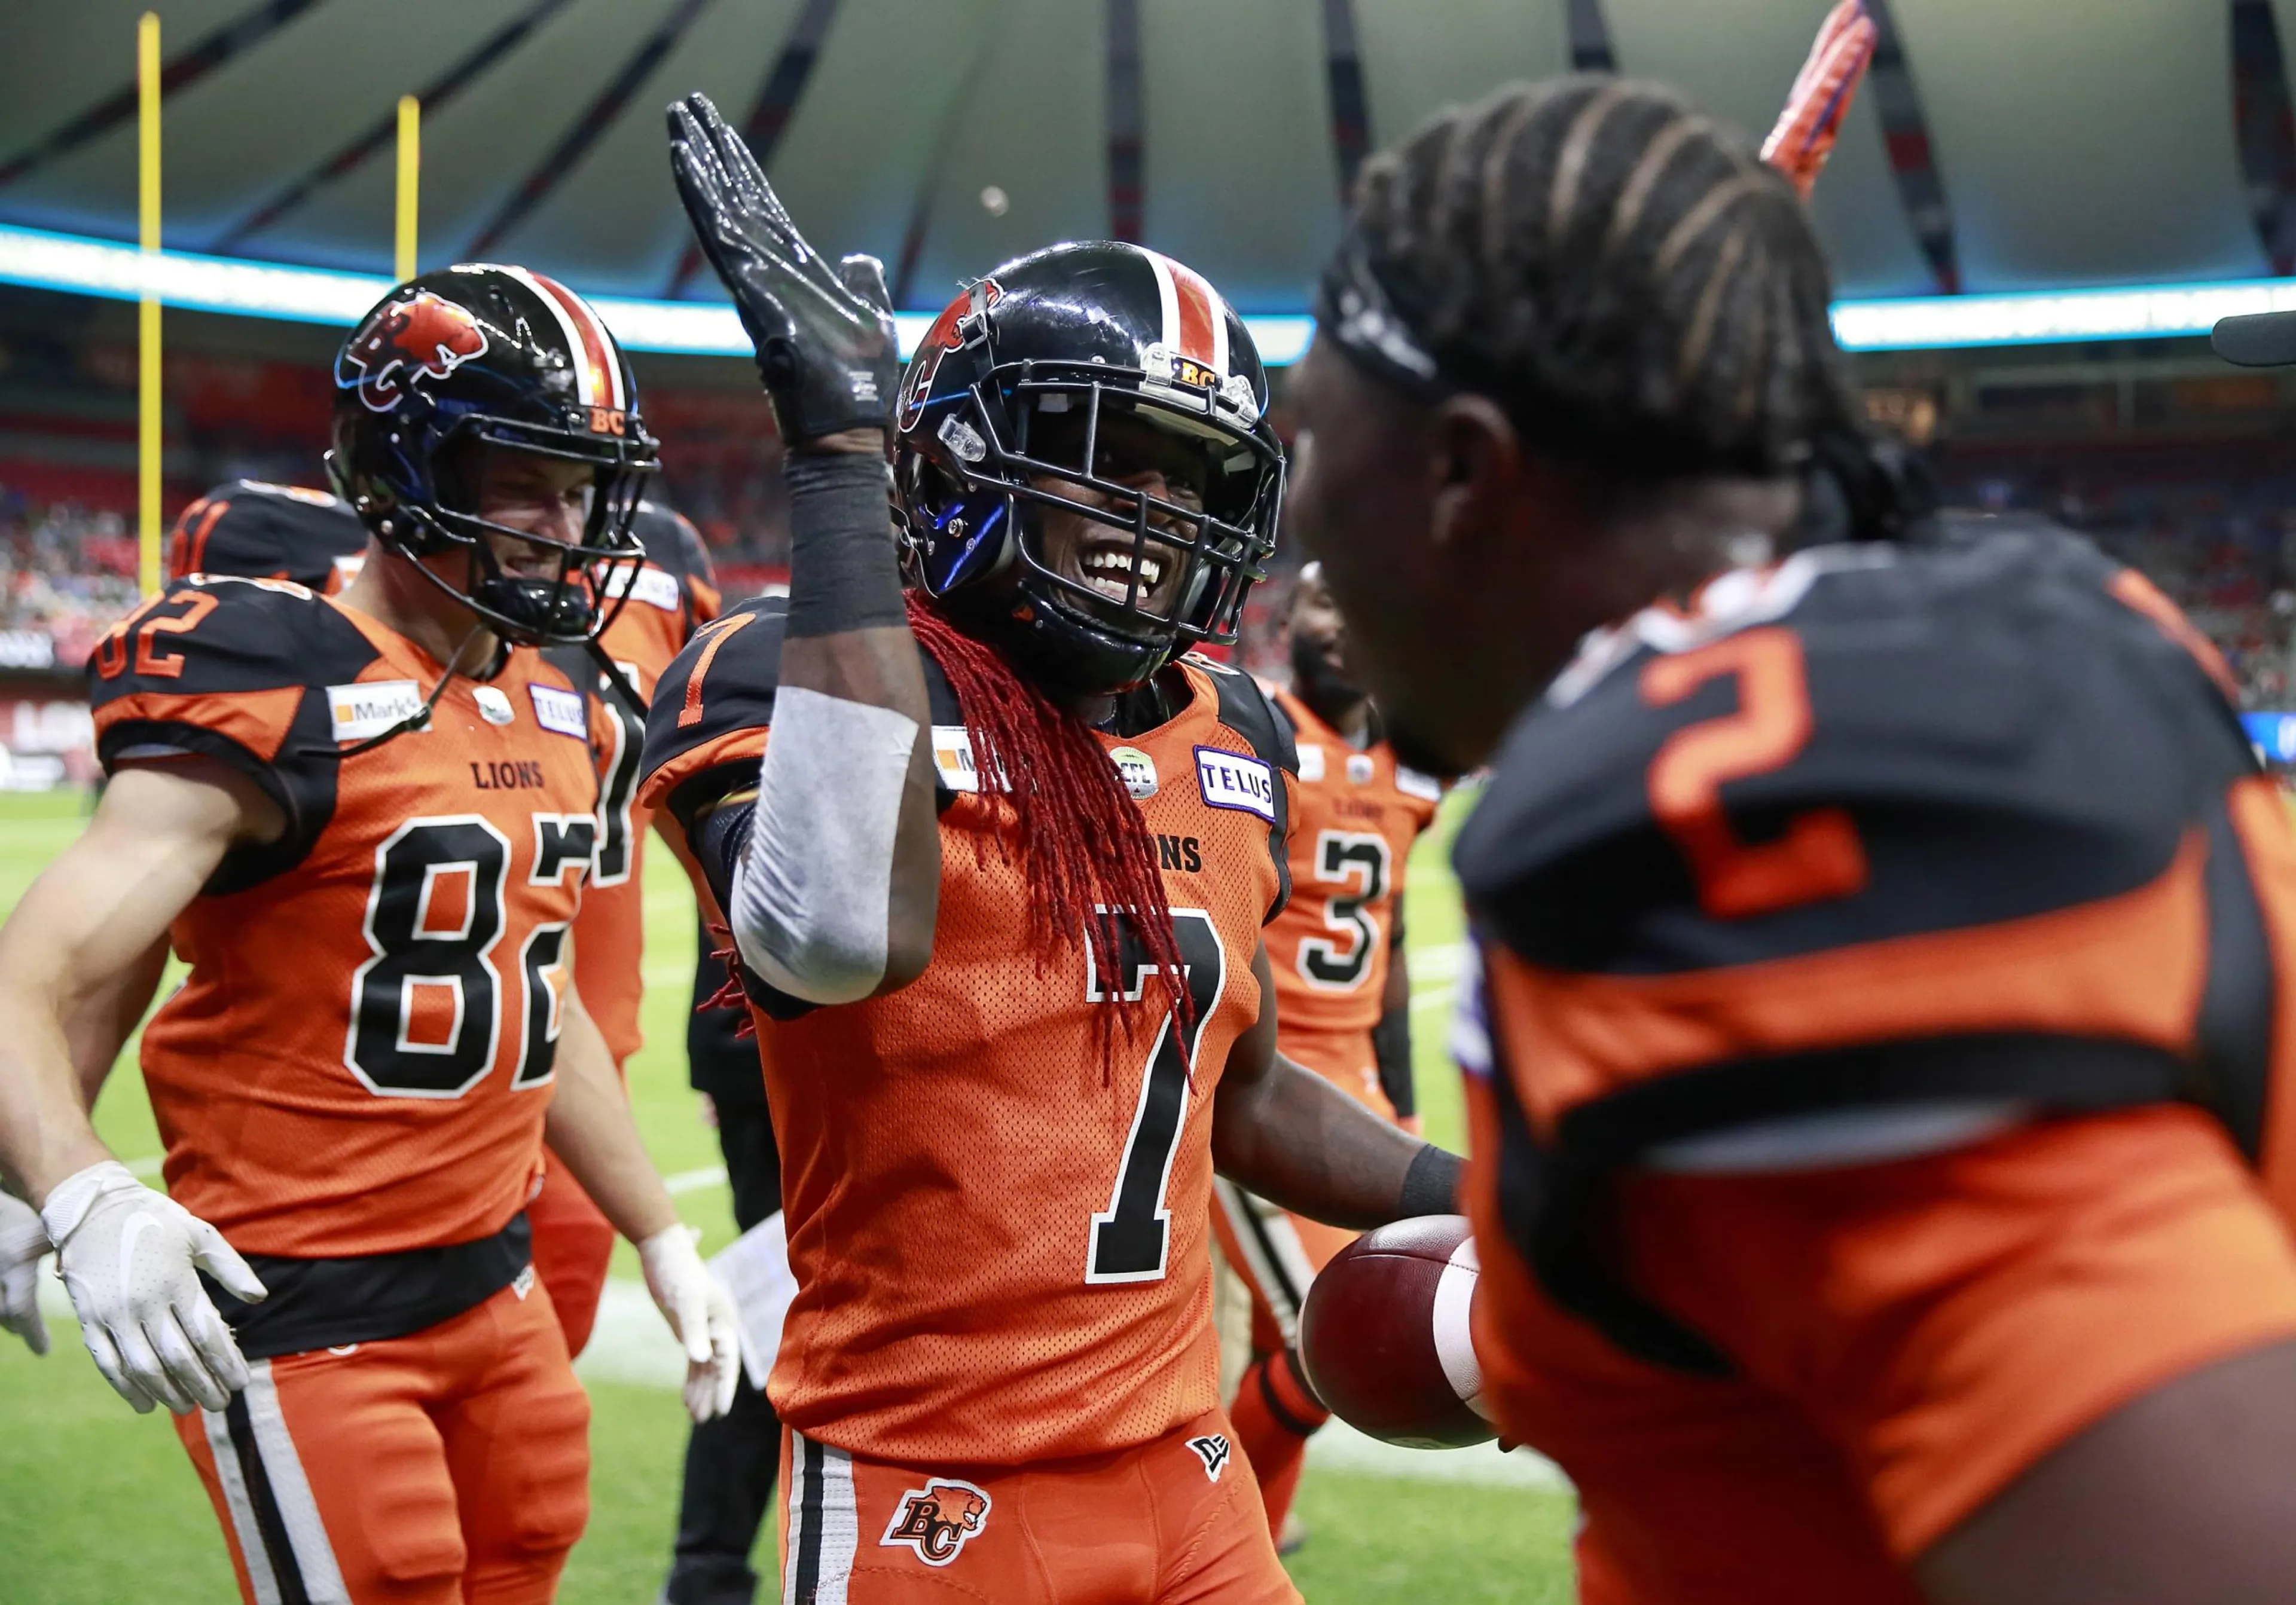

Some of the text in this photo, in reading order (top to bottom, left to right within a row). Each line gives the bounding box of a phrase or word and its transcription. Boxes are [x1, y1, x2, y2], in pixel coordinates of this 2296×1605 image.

[1181, 362, 1215, 387] BC
[590, 408, 625, 436] BC
[470, 760, 545, 789] LIONS
[1202, 763, 1272, 803] TELUS
[1637, 626, 1871, 924] 2
[1295, 829, 1392, 994] 3
[1085, 903, 1226, 1285] 7
[889, 1496, 964, 1561] BC
